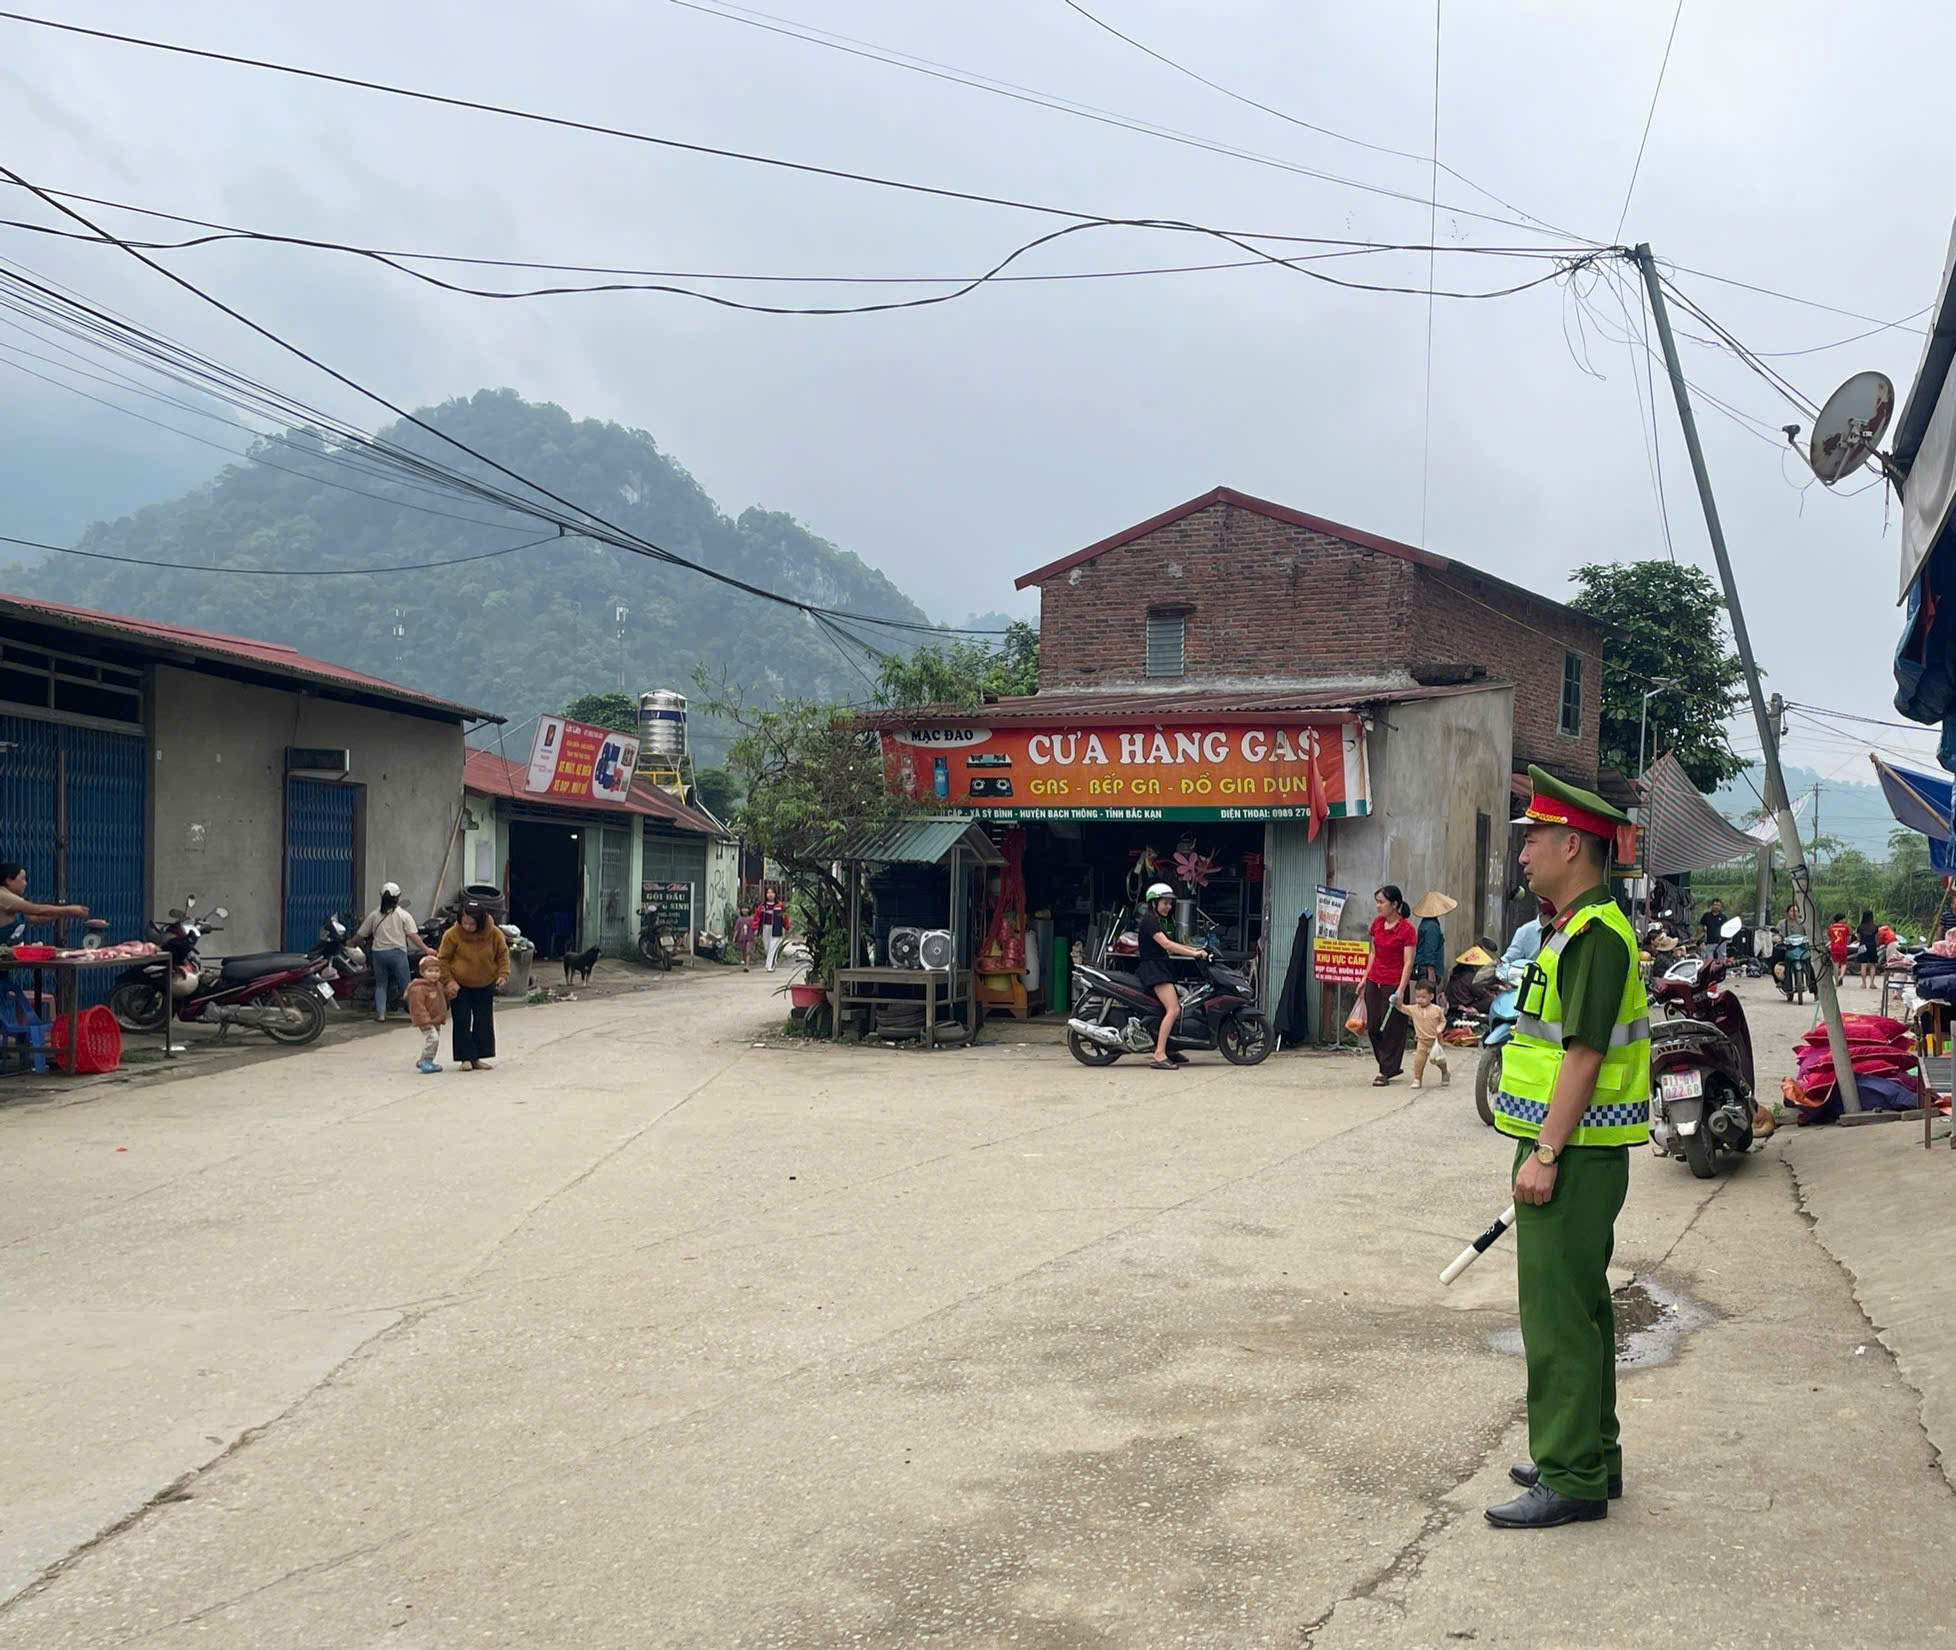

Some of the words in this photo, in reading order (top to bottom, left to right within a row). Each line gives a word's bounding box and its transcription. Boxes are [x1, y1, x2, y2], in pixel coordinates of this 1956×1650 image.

[911, 729, 941, 744] MẠC
[1119, 724, 1229, 764] HÀNG
[1240, 729, 1321, 763] GAS
[1030, 778, 1069, 794] GAS
[1089, 773, 1124, 794] BẾP
[1131, 778, 1160, 794] GA
[1180, 772, 1212, 794] ĐỒ
[1219, 777, 1256, 793] GIA
[1263, 776, 1327, 798] DỤN
[994, 807, 1013, 818] BÌNH
[1020, 808, 1046, 820] HUYỆN
[1048, 809, 1069, 820] BẠCH
[1071, 808, 1098, 819] THÔNG
[1125, 807, 1142, 818] BẮC
[1144, 809, 1162, 820] KẠN
[1221, 808, 1241, 820] ĐIỆN
[1243, 809, 1270, 820] THOẠI:
[1272, 809, 1293, 818] 0989
